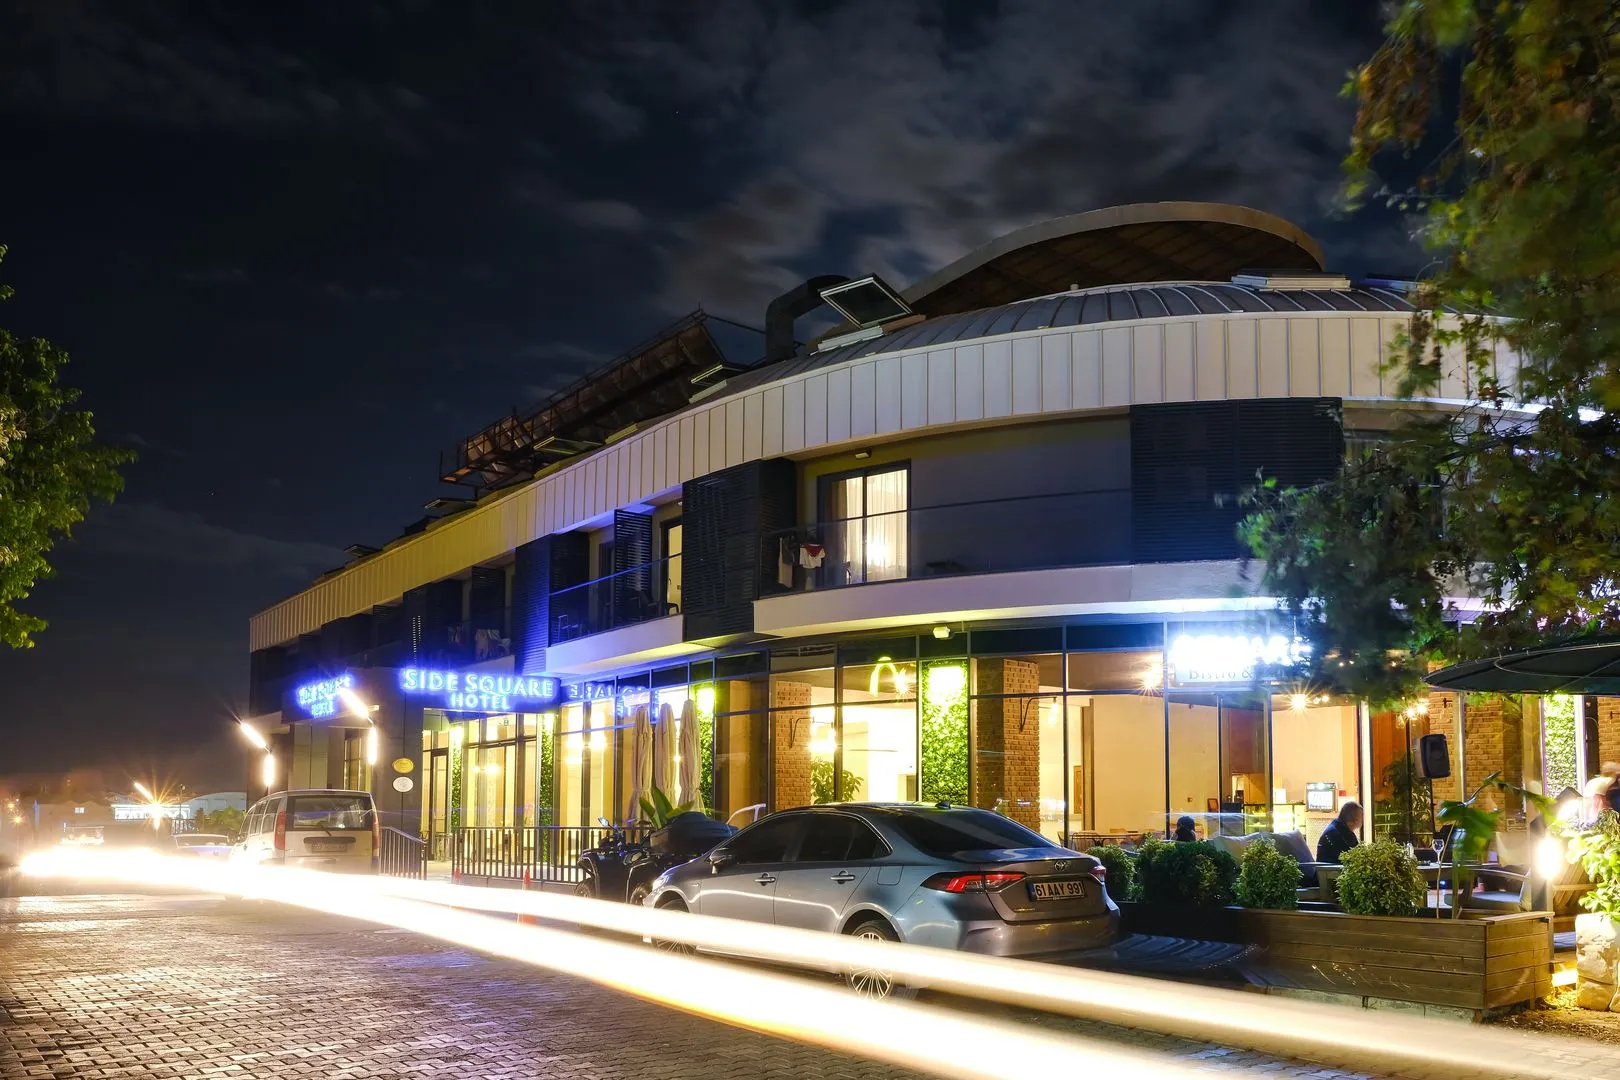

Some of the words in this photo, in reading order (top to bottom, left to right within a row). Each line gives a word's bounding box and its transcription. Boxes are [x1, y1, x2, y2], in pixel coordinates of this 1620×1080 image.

[404, 668, 459, 690] SIDE
[465, 673, 554, 697] SQUARE
[450, 692, 510, 710] HOTEL
[1035, 884, 1047, 897] 61
[1048, 883, 1065, 896] AAY
[1067, 882, 1084, 895] 991
